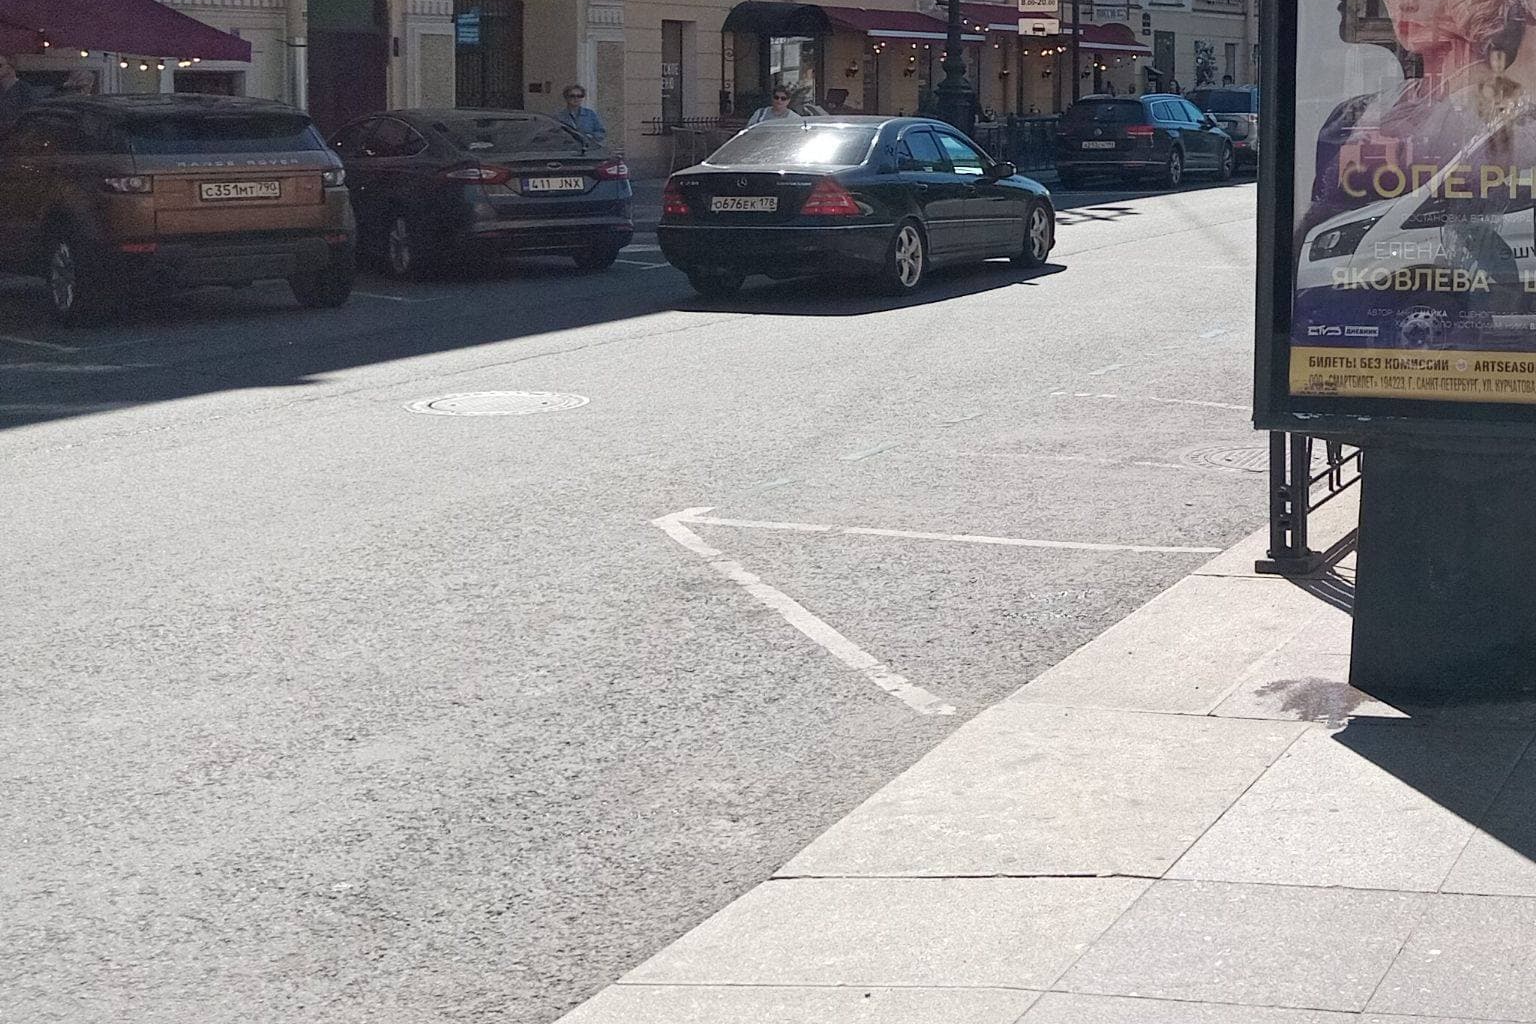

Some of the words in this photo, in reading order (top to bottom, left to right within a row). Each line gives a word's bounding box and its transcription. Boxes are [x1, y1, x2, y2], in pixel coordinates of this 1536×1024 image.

[205, 184, 256, 197] С351МТ
[258, 182, 278, 193] 790
[532, 179, 552, 189] 411
[559, 178, 581, 189] JNX
[760, 198, 776, 208] 178
[1374, 241, 1446, 261] ЕЛЕНА
[1331, 267, 1491, 293] ЯКОВЛЕВА
[1309, 356, 1356, 369] БИЛЕТЫ
[1360, 357, 1381, 369] БЕЗ
[1385, 358, 1449, 371] КОМИССИИ
